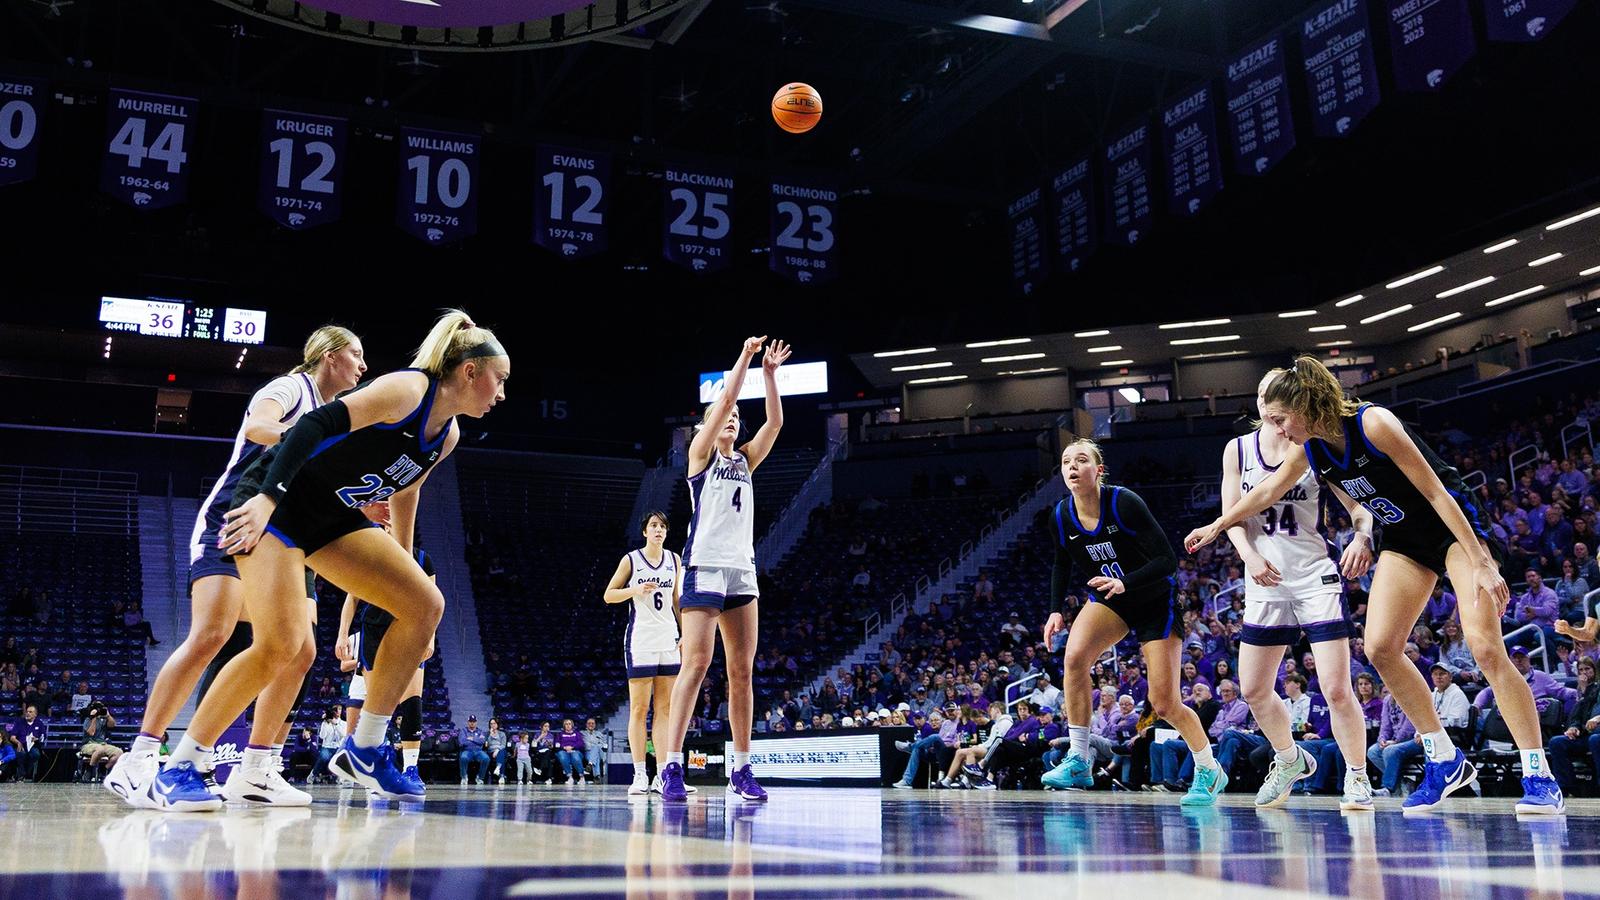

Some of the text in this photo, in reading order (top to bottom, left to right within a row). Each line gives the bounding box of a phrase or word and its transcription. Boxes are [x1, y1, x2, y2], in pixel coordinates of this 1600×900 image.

[1228, 40, 1278, 78] K-STATE
[1304, 47, 1333, 70] SWEET
[1333, 28, 1366, 55] SIXTEEN
[1227, 74, 1283, 111] SWEET SIXTEEN
[118, 98, 188, 118] MURRELL
[1164, 88, 1208, 125] K-STATE
[276, 119, 334, 137] KRUGER
[109, 117, 187, 174] 44
[407, 136, 474, 154] WILLIAMS
[269, 137, 337, 194] 12
[553, 155, 595, 170] EVANS
[119, 175, 170, 191] 1962-64
[407, 154, 471, 209] 10
[665, 170, 734, 190] BLACKMAN
[542, 171, 603, 225] 12
[772, 184, 837, 202] RICHMOND
[275, 197, 323, 211] 1971-74
[669, 188, 731, 240] 25
[414, 213, 459, 227] 1972-76
[776, 201, 835, 253] 23
[785, 256, 826, 269] 1986-88
[149, 313, 174, 329] 36
[195, 307, 214, 318] 1:25
[105, 321, 138, 332] 4:44 PM
[193, 330, 211, 339] FOULS
[232, 320, 256, 336] 30
[538, 399, 568, 420] 15
[384, 454, 423, 486] BYU
[1341, 475, 1376, 499] BYU
[731, 486, 742, 513] 4
[1260, 503, 1298, 538] 34
[1085, 541, 1117, 561] BYU
[653, 591, 663, 611] 6
